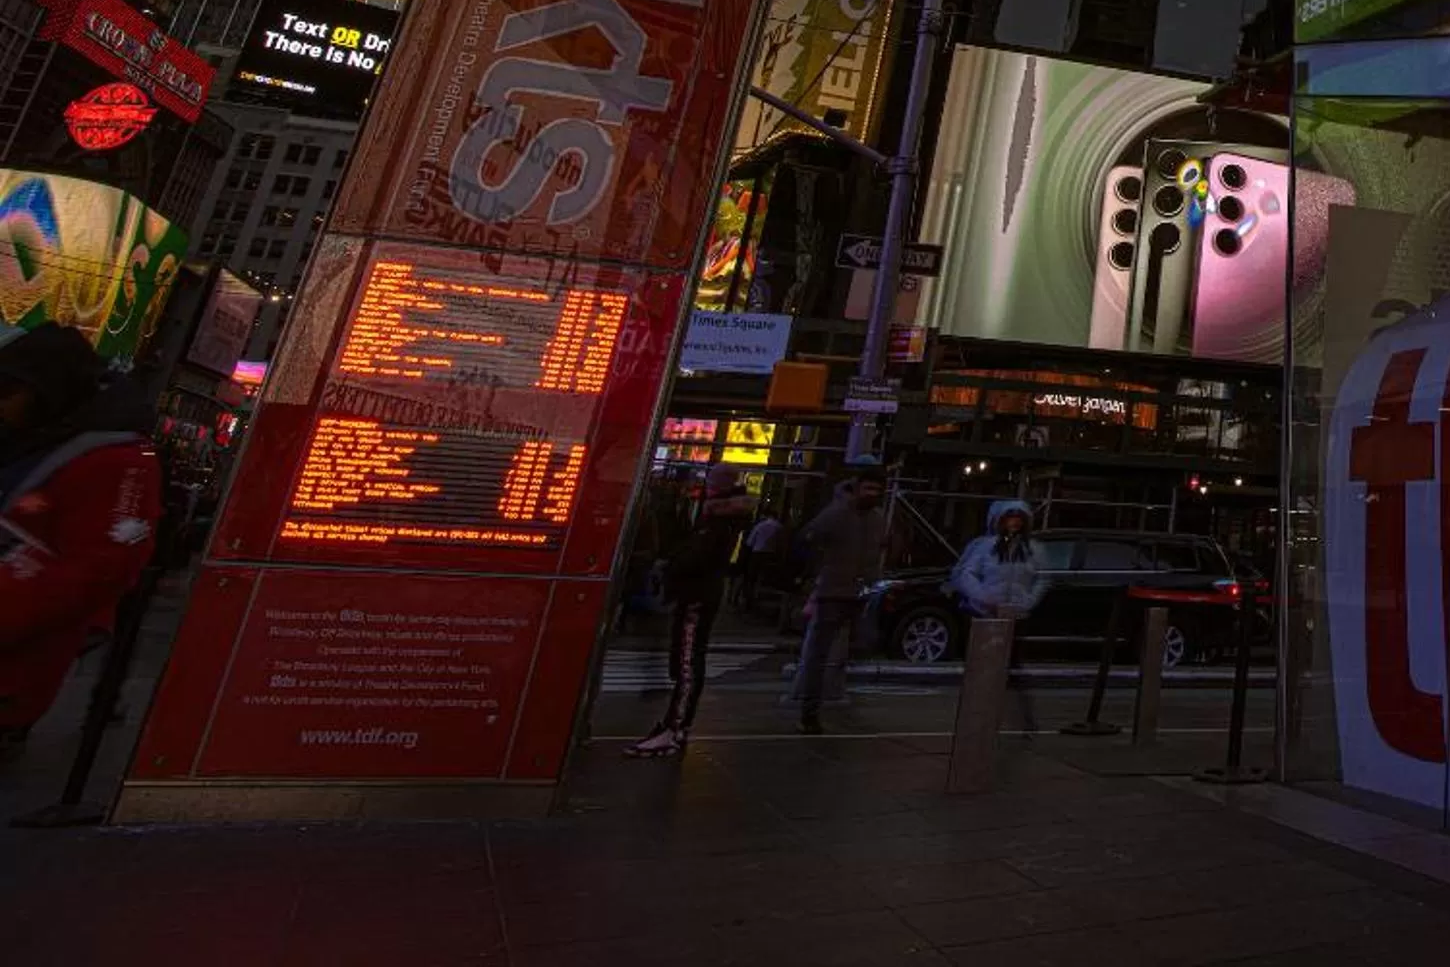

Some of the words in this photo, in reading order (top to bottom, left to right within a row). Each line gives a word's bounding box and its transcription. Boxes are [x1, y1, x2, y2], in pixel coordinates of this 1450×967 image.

[283, 13, 328, 38] Text
[331, 26, 361, 49] OR
[265, 30, 322, 58] There
[347, 51, 375, 70] No
[301, 725, 418, 749] www.tdf.org
